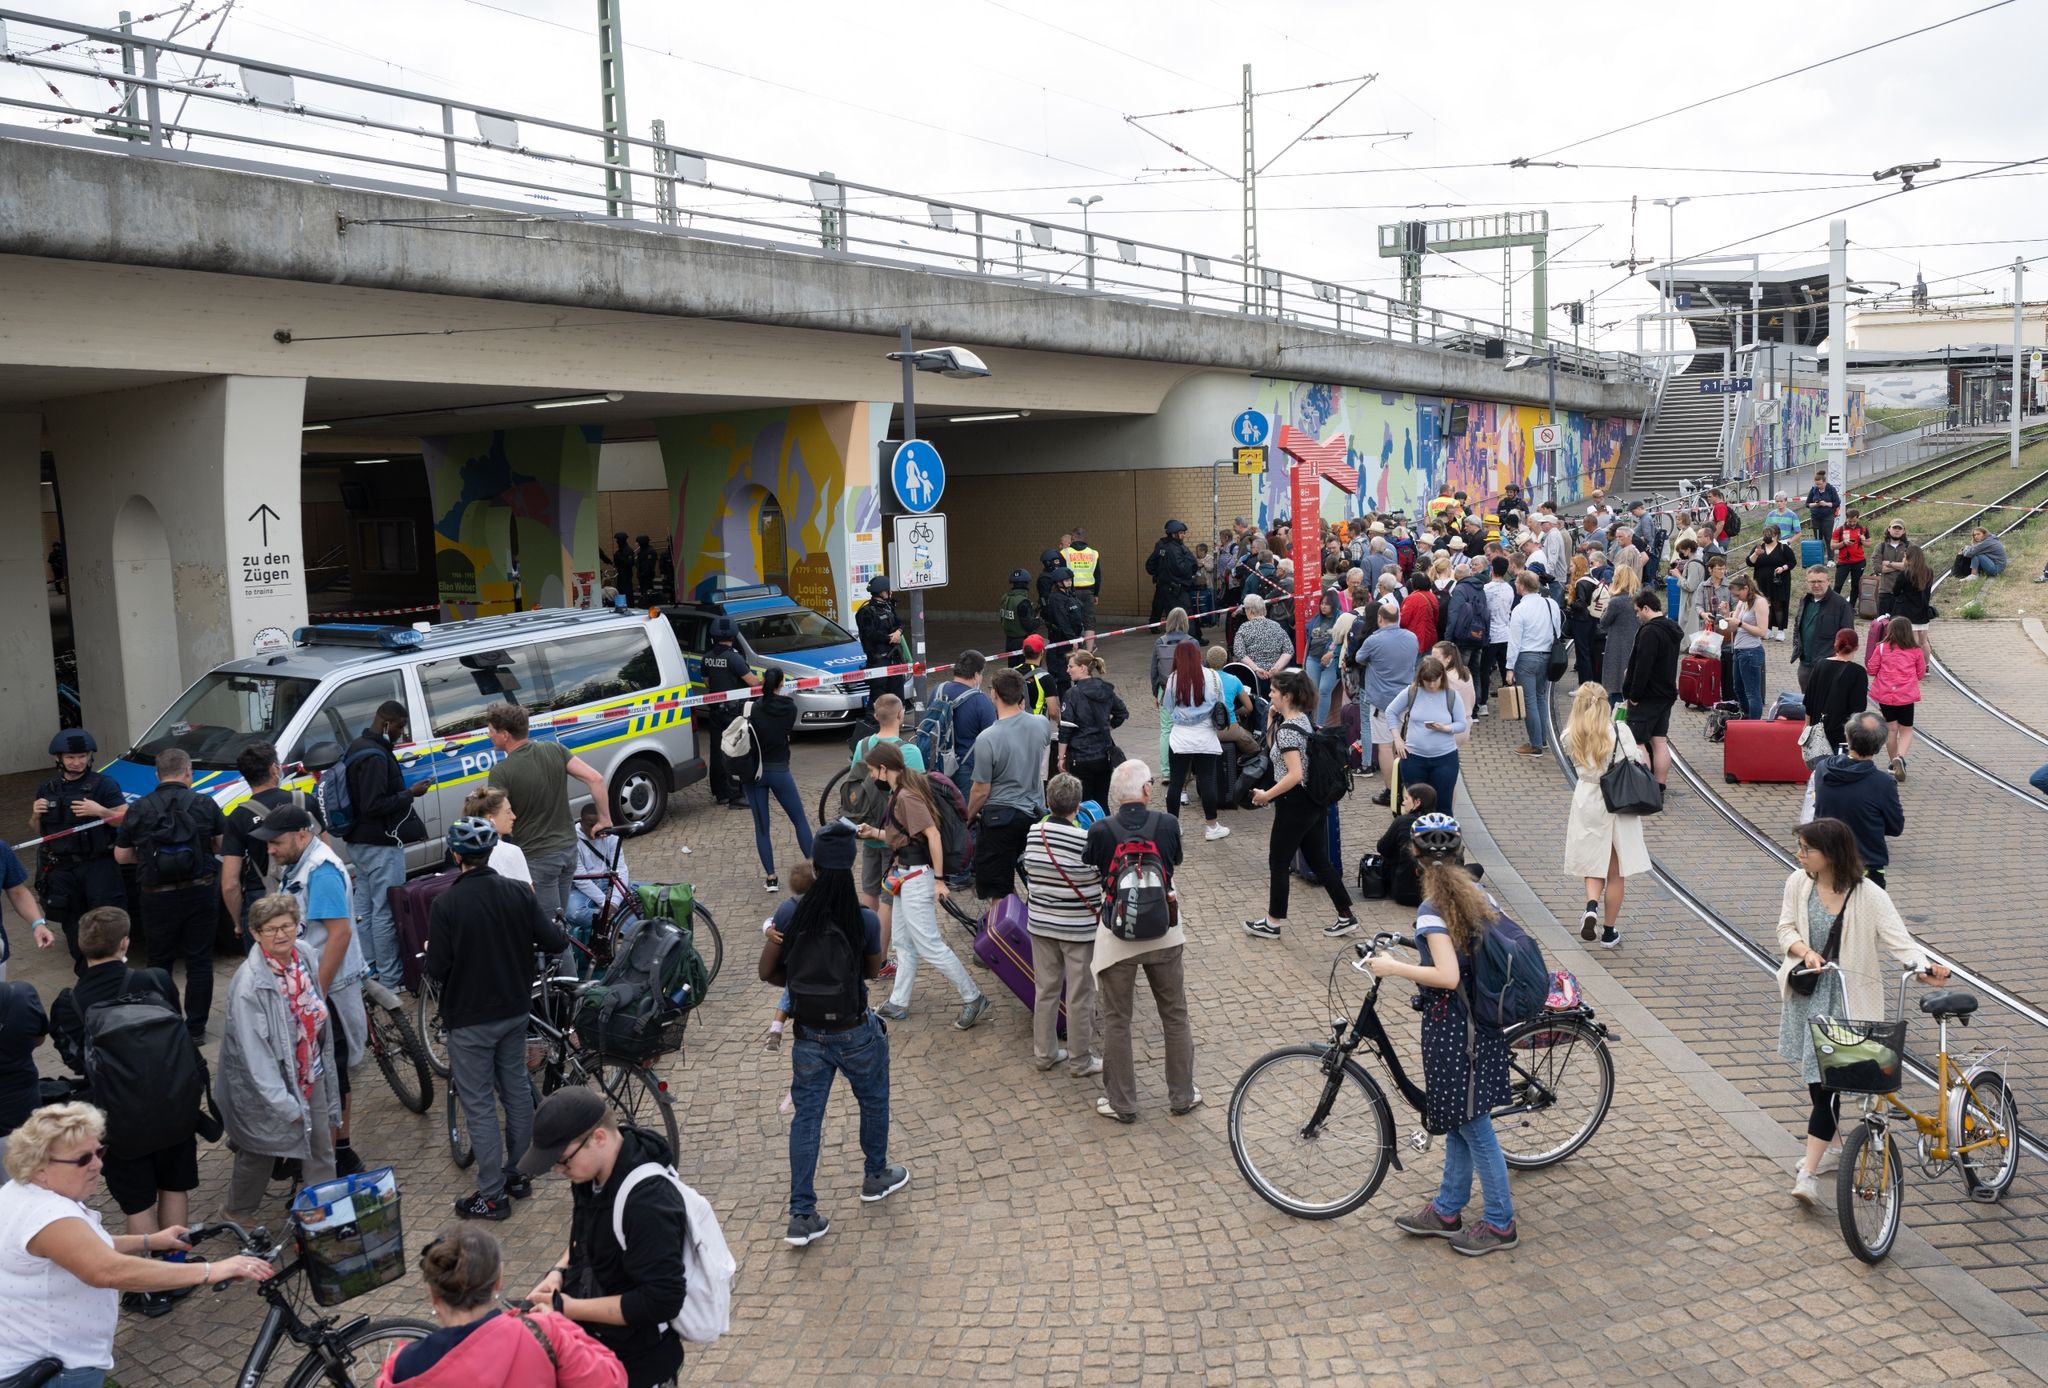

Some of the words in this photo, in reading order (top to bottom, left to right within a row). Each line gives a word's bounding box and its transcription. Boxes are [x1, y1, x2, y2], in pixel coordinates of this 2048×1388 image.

[1678, 295, 1683, 305] 1
[1712, 381, 1717, 389] 1
[1735, 379, 1740, 388] 1
[1829, 415, 1840, 433] E
[242, 556, 259, 566] zu
[264, 553, 290, 565] den
[243, 569, 289, 583] Zügen
[916, 570, 931, 583] frei
[438, 581, 454, 591] Ellen
[454, 582, 476, 592] Weber
[798, 583, 828, 595] Louise
[794, 595, 833, 607] Caroline
[704, 657, 728, 668] POLIZEI
